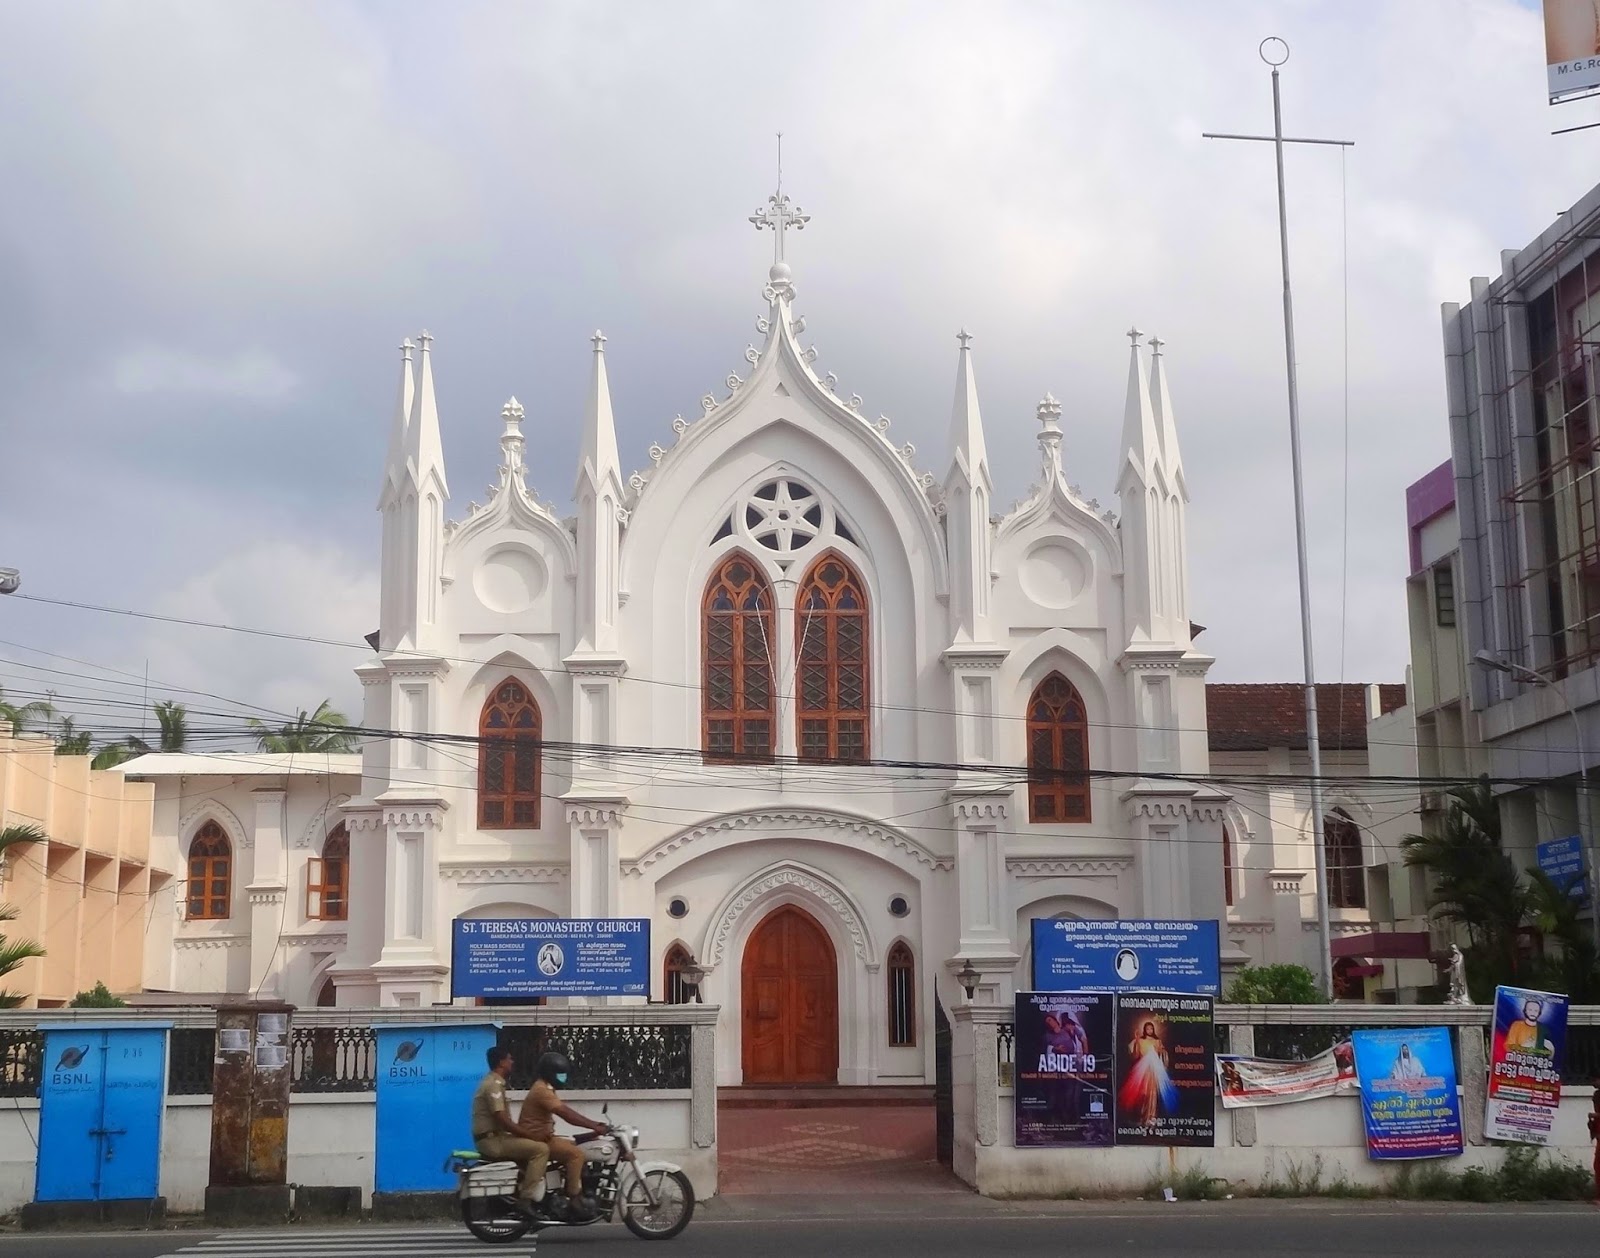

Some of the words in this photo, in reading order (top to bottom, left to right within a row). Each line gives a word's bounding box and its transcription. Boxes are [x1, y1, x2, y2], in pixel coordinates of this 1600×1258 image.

[462, 922, 477, 933] ST.
[480, 920, 527, 933] TERESA'S
[530, 921, 594, 933] MONASTERY
[596, 921, 641, 932] CHURCH
[1038, 1053, 1077, 1072] ABIDE
[1081, 1054, 1096, 1072] 19
[389, 1066, 427, 1077] BSNL
[53, 1073, 92, 1085] BSNL
[1179, 1128, 1194, 1136] 7.30
